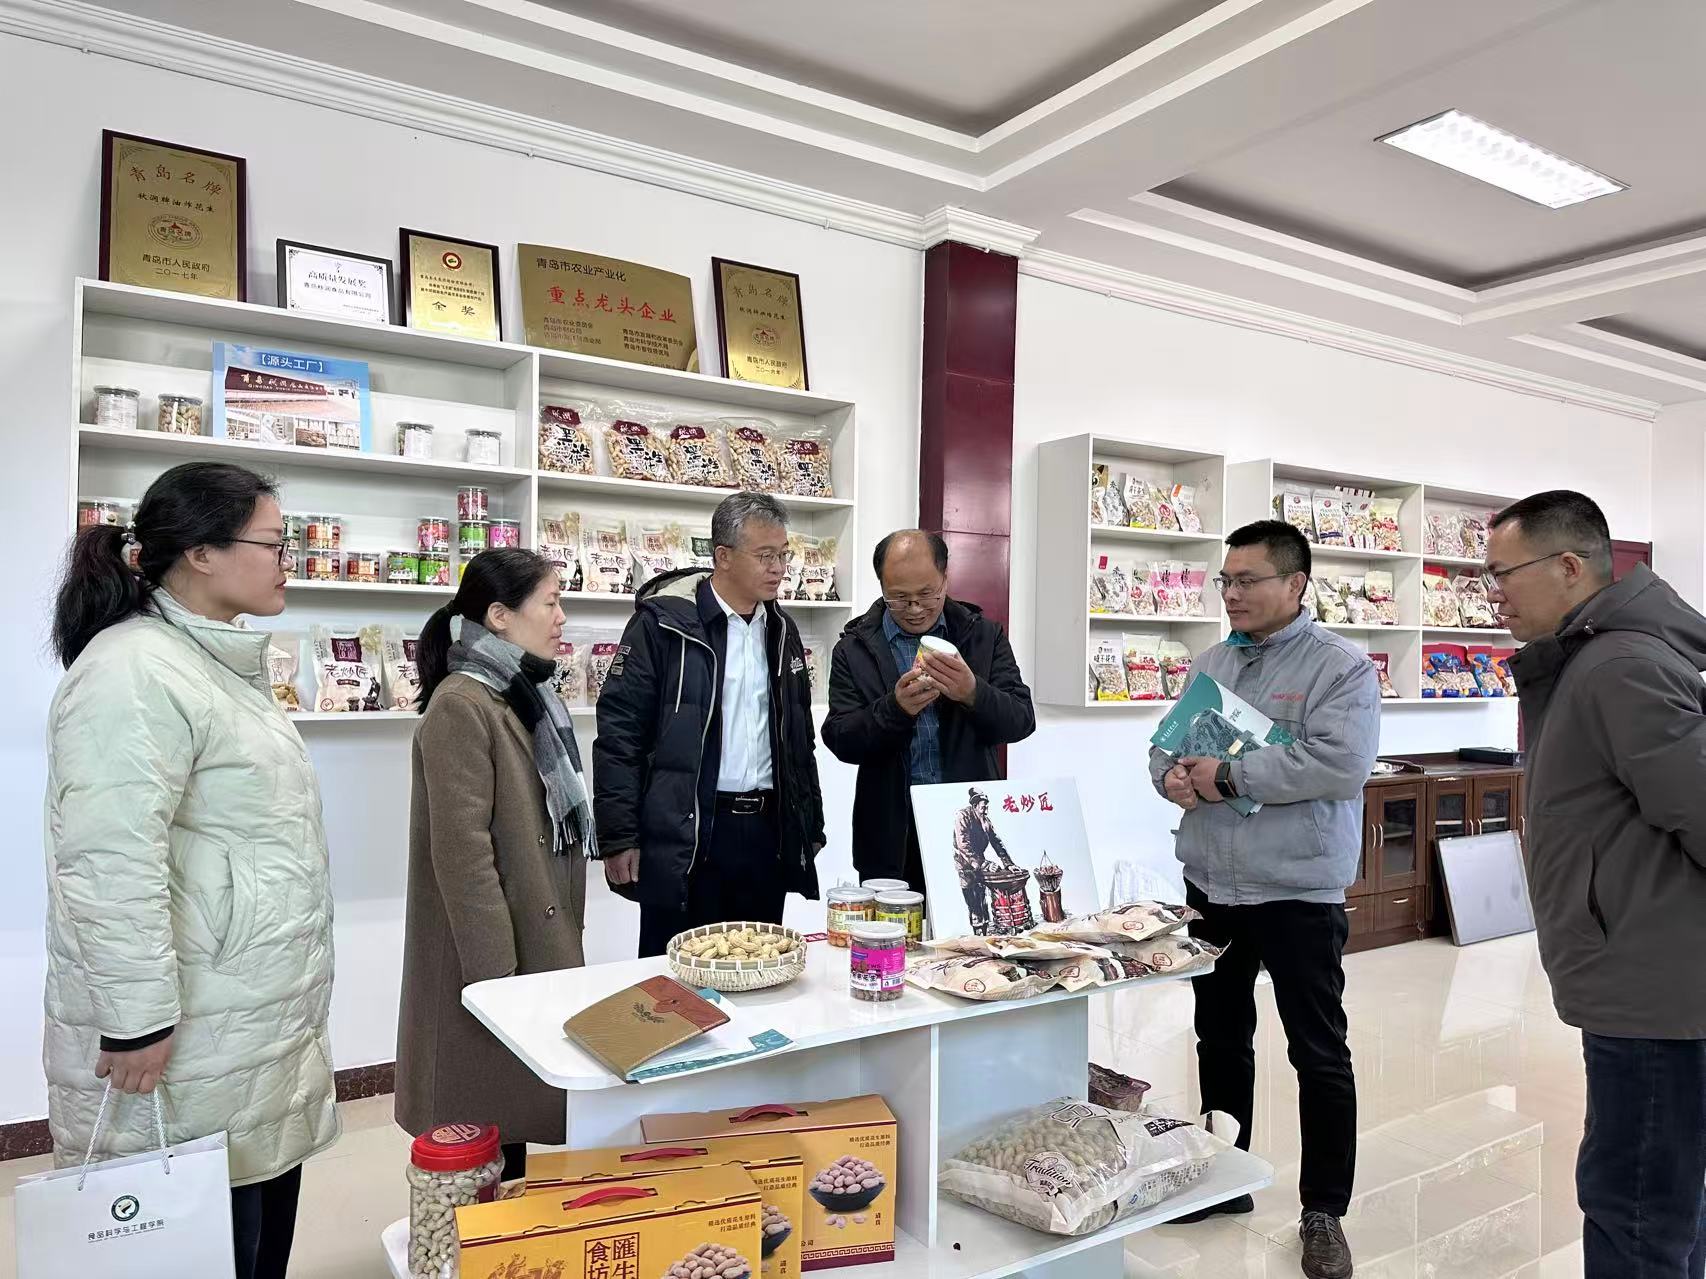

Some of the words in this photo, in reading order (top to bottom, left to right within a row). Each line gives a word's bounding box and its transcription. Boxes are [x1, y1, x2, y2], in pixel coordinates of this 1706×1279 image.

[142, 253, 210, 272] 青岛市人民政府
[537, 257, 627, 282] 青岛市农业产业化
[547, 286, 677, 324] 重点龙头企业
[1002, 792, 1054, 813] 老炒匠
[1025, 1159, 1071, 1185] Tradition
